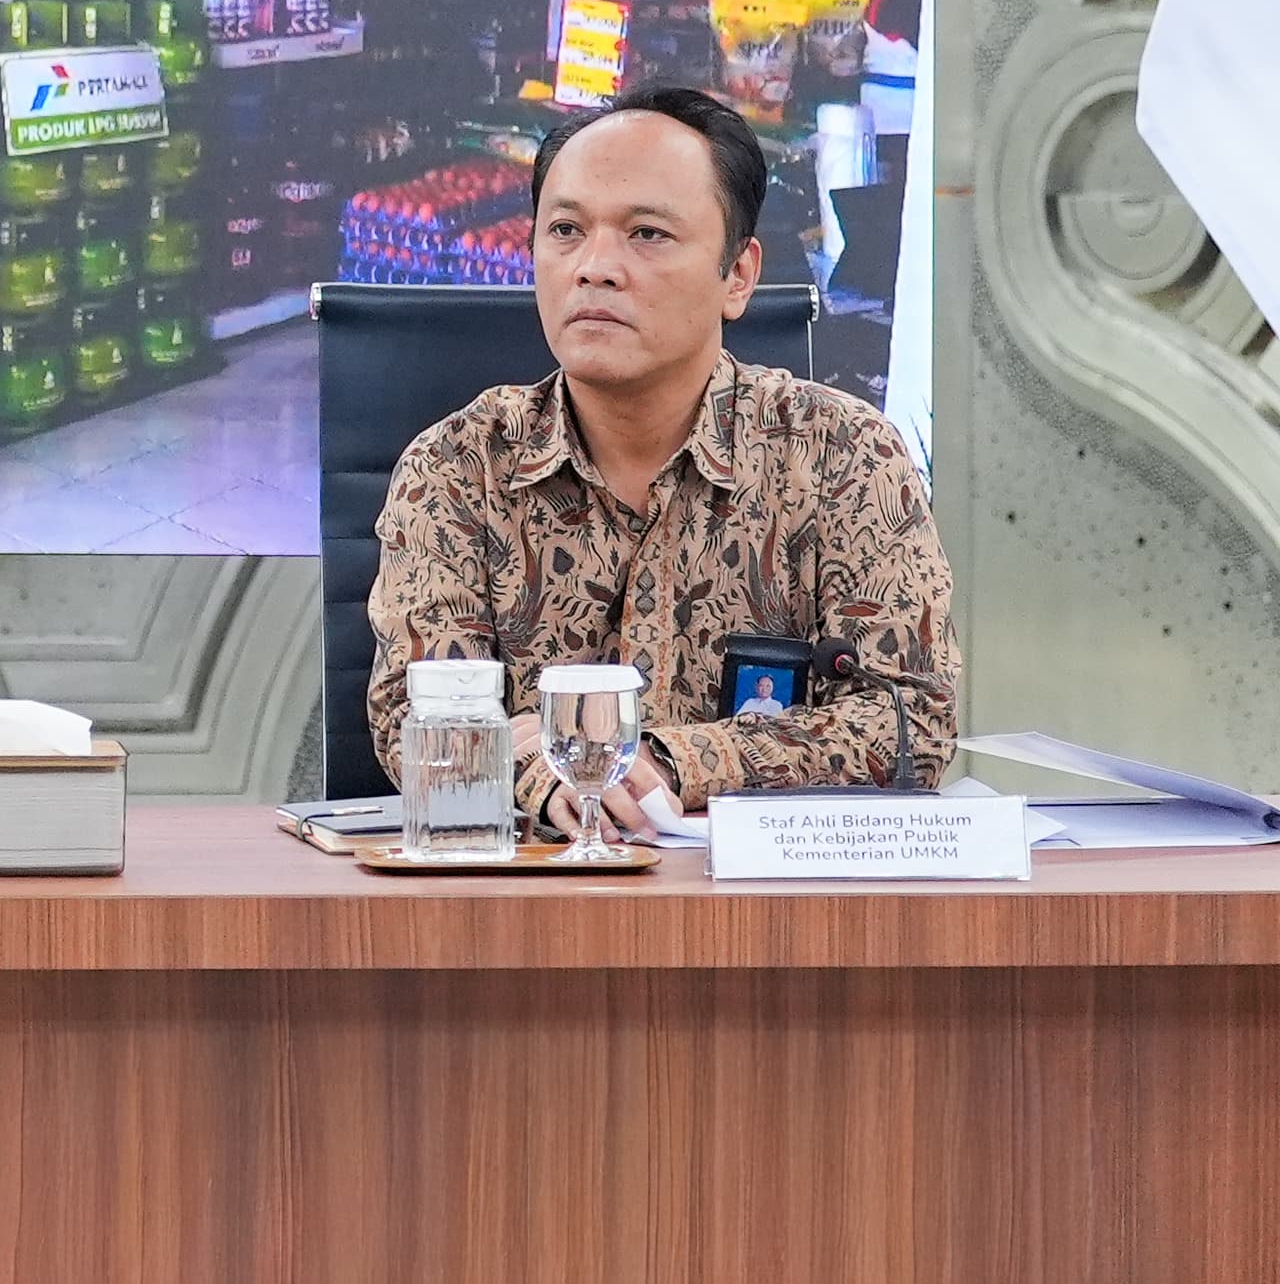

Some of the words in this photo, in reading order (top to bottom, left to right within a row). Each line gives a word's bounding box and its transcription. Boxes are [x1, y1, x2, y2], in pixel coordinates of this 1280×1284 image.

[17, 120, 86, 145] PRODUK
[88, 115, 115, 135] LPG
[759, 815, 795, 829] Staf
[801, 815, 836, 829] Ahli
[842, 814, 904, 829] Bidang
[909, 813, 972, 827] Hukum
[774, 833, 806, 845] dan
[812, 831, 898, 847] Kebijakan
[904, 829, 959, 843] Publik
[783, 847, 895, 861] Kementerian
[900, 846, 959, 860] UMKM
